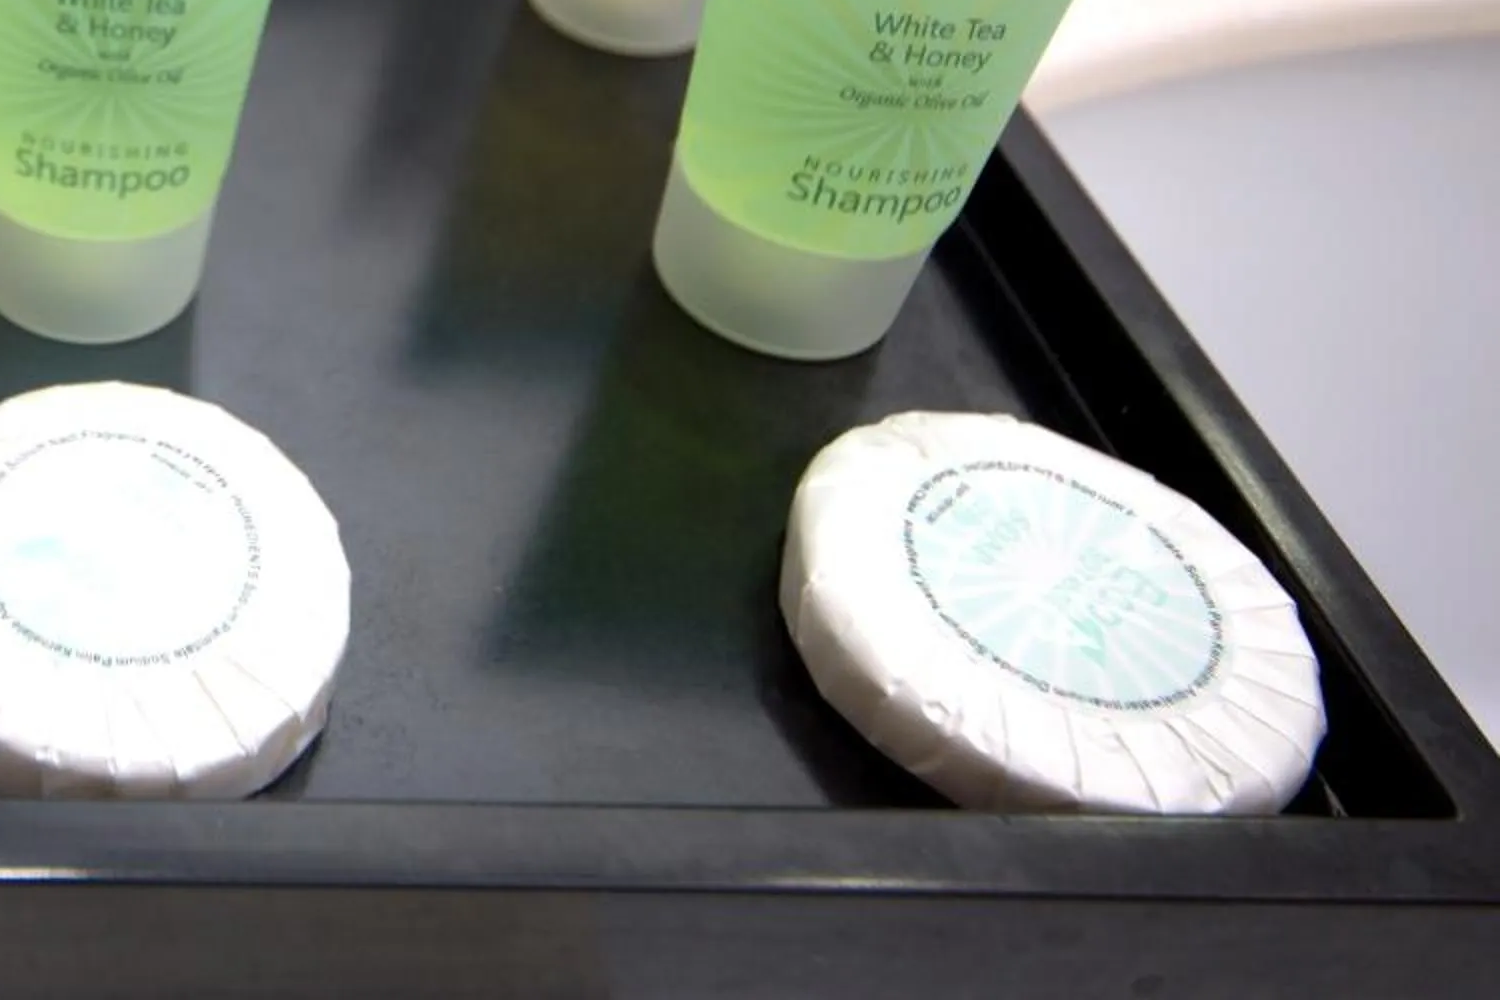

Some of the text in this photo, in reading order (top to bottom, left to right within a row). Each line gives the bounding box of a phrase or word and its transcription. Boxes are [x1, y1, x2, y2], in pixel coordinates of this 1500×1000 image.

[56, 14, 177, 48] & Honey
[875, 11, 1007, 41] White Tea
[869, 40, 992, 74] & Honey
[839, 83, 907, 112] Organic
[22, 129, 190, 158] NOURISHING
[15, 147, 190, 198] Shampoo
[803, 154, 969, 184] NOURISHING
[786, 171, 962, 225] Shampoo
